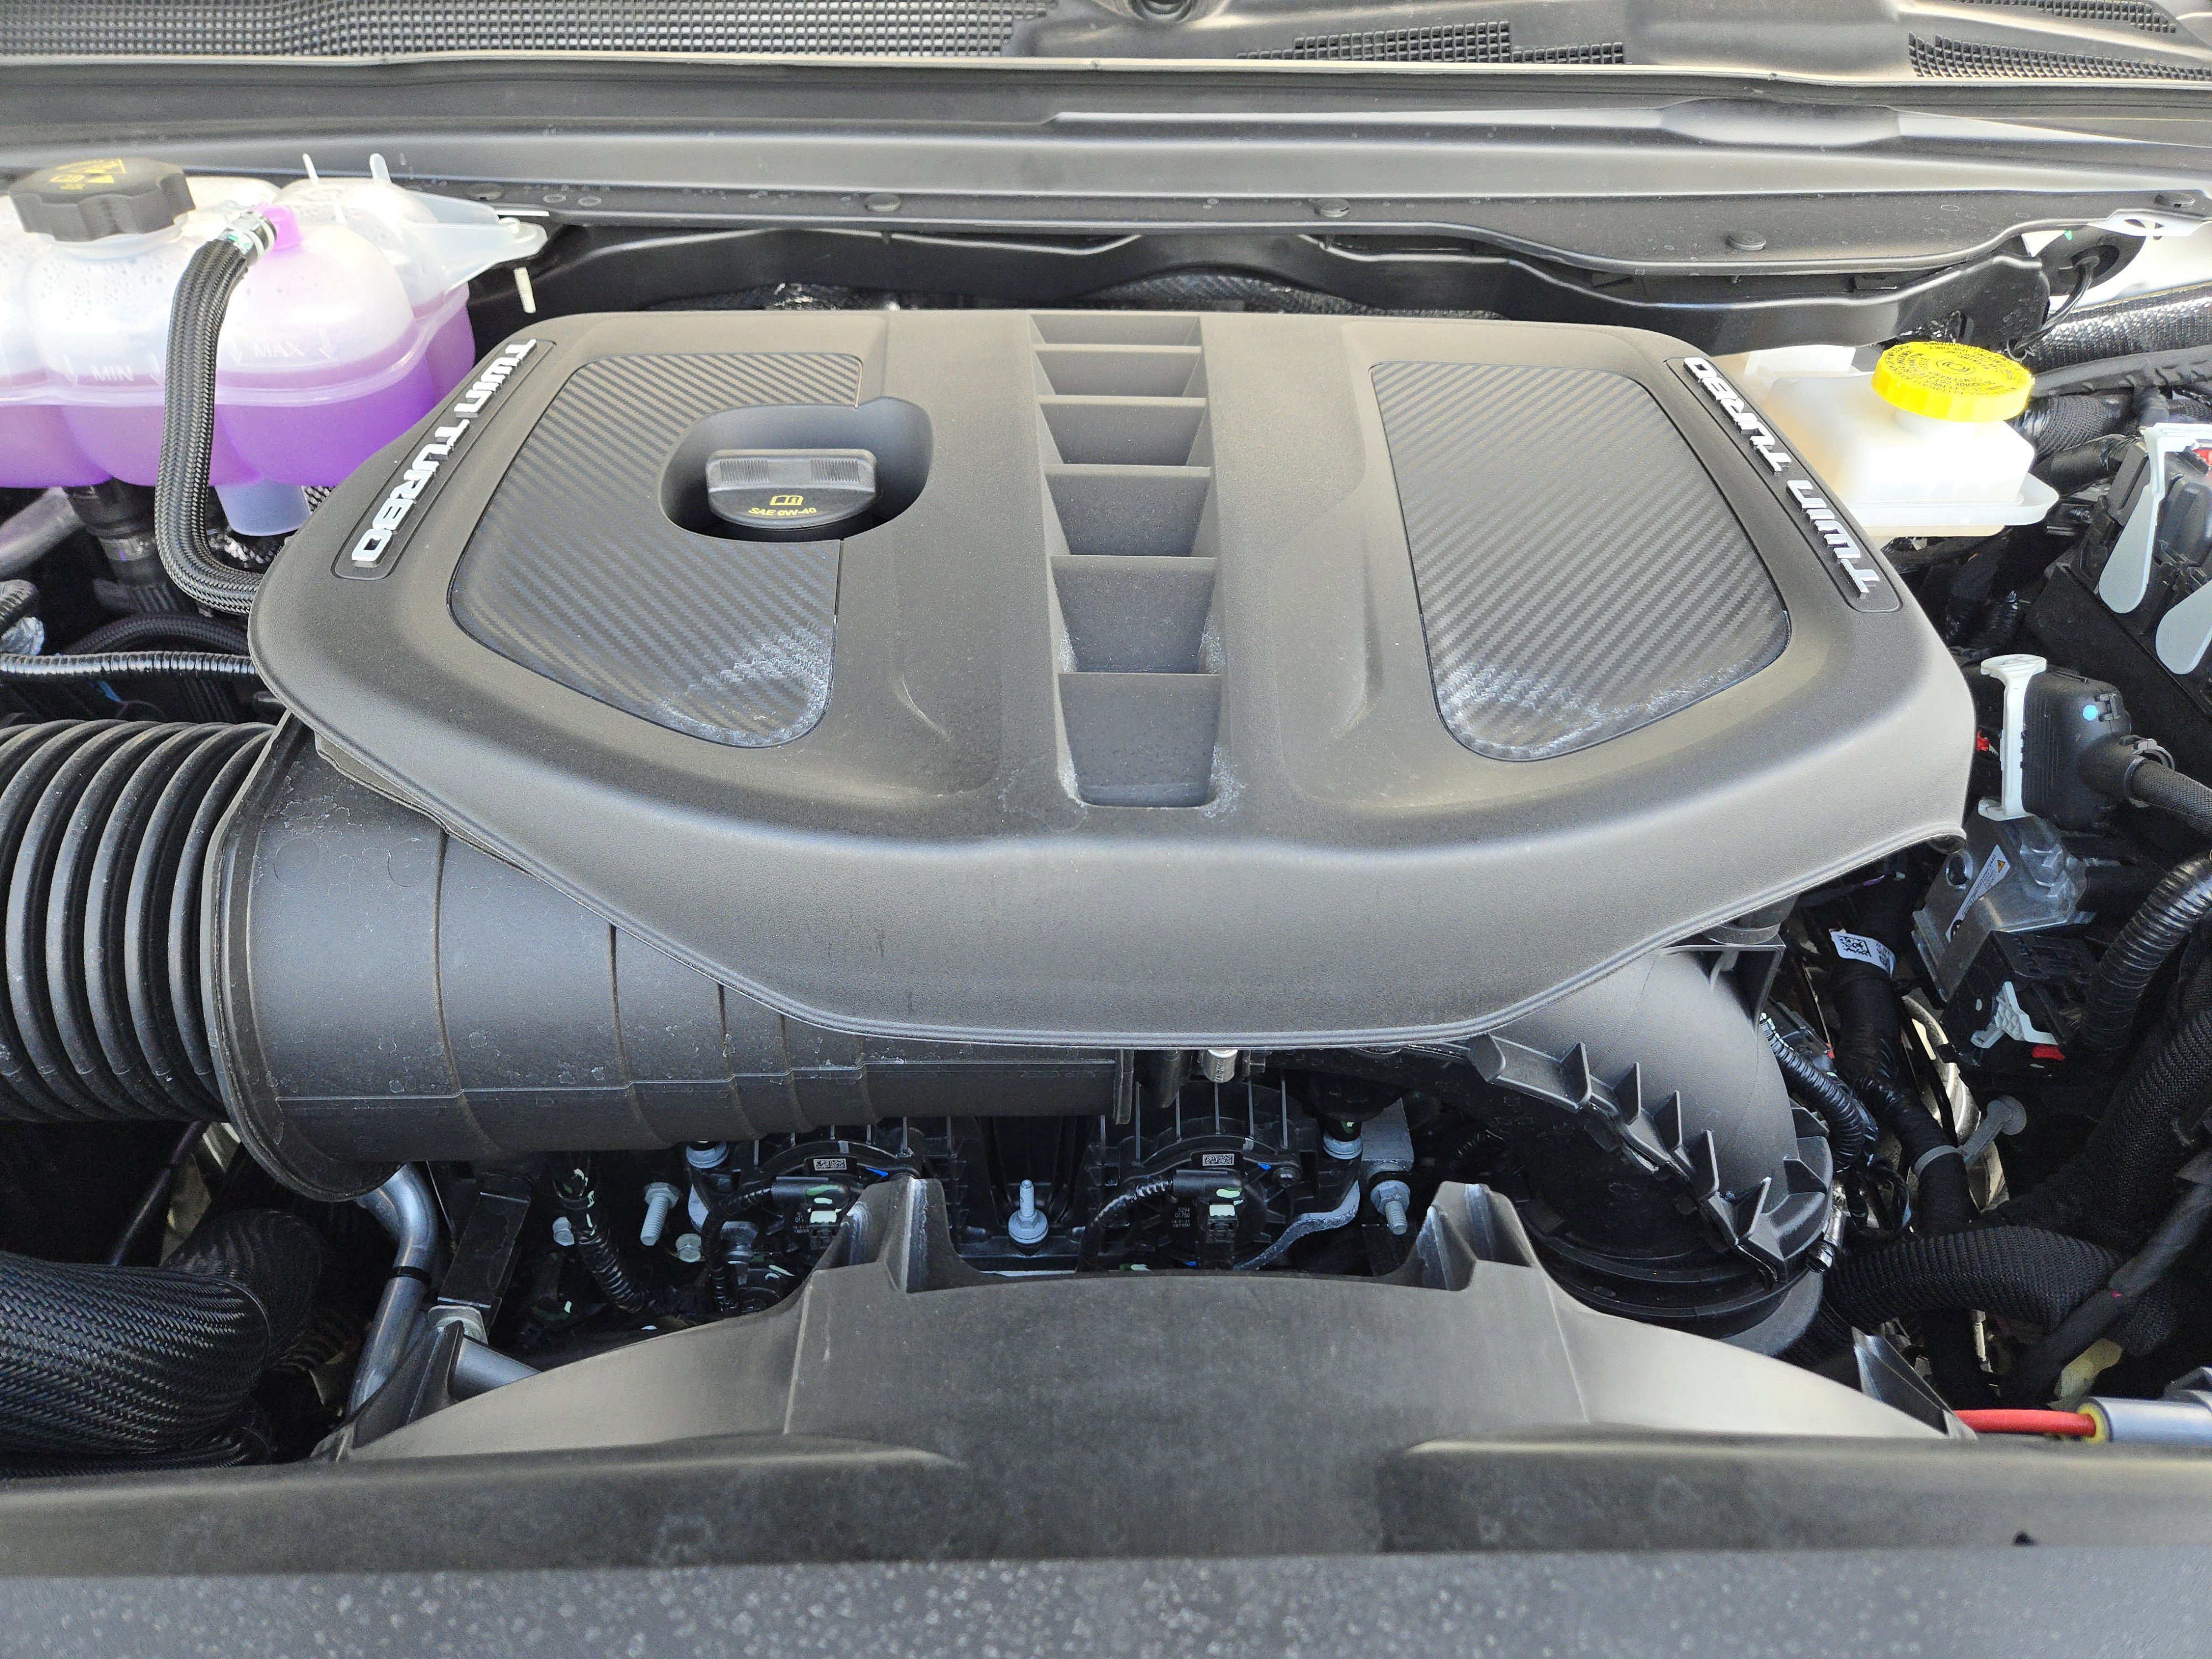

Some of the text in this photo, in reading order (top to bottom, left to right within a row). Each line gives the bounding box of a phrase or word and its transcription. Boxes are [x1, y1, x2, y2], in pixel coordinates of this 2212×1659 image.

[253, 340, 306, 358] MAX
[90, 364, 134, 382] MIN
[351, 338, 537, 565] TWIN TURBO
[1683, 357, 1880, 598] TWIN TURBO
[777, 508, 817, 516] 0W-40
